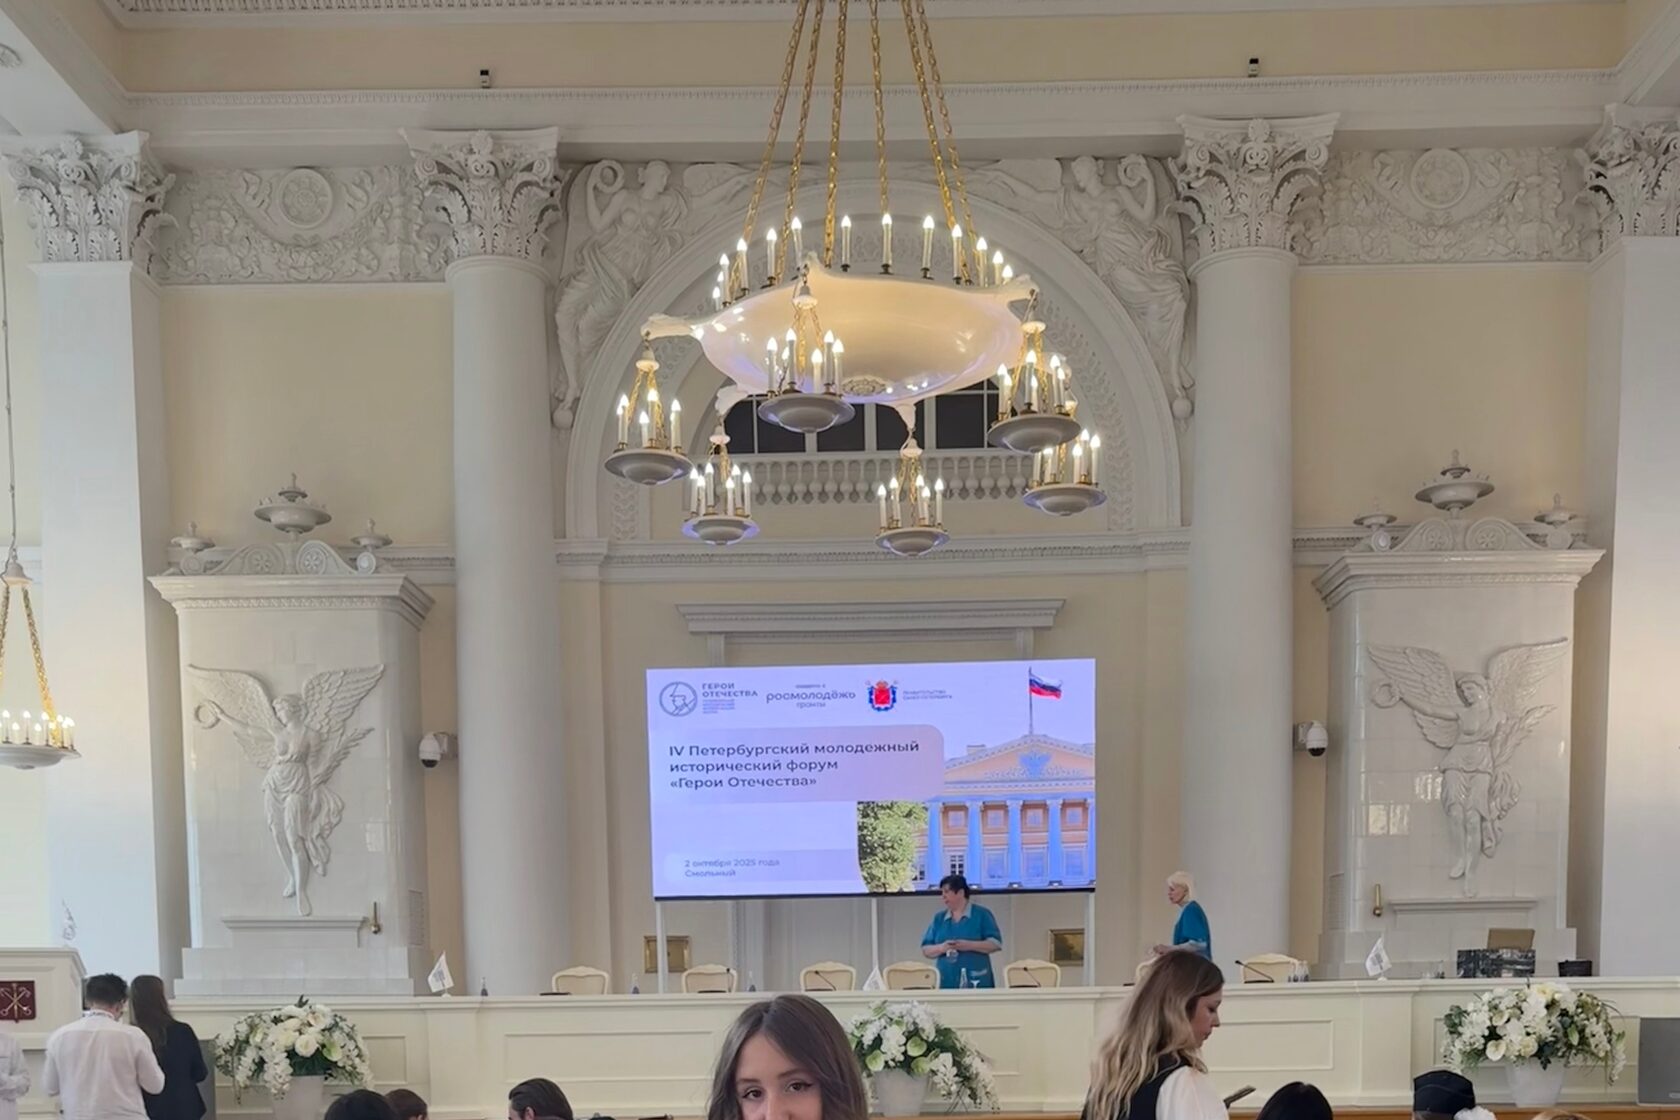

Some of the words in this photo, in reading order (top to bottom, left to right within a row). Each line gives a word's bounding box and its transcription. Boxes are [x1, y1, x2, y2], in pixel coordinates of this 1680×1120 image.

[702, 682, 735, 690] ГЕРОИ
[702, 690, 758, 698] ОТЕЧЕСТВА
[669, 746, 685, 757] IV
[689, 743, 809, 759] Петербургский
[814, 740, 919, 755] молодежный
[670, 758, 782, 774] исторический
[786, 758, 838, 774] форум
[670, 777, 724, 791] «Герои
[728, 776, 817, 789] Отечества»
